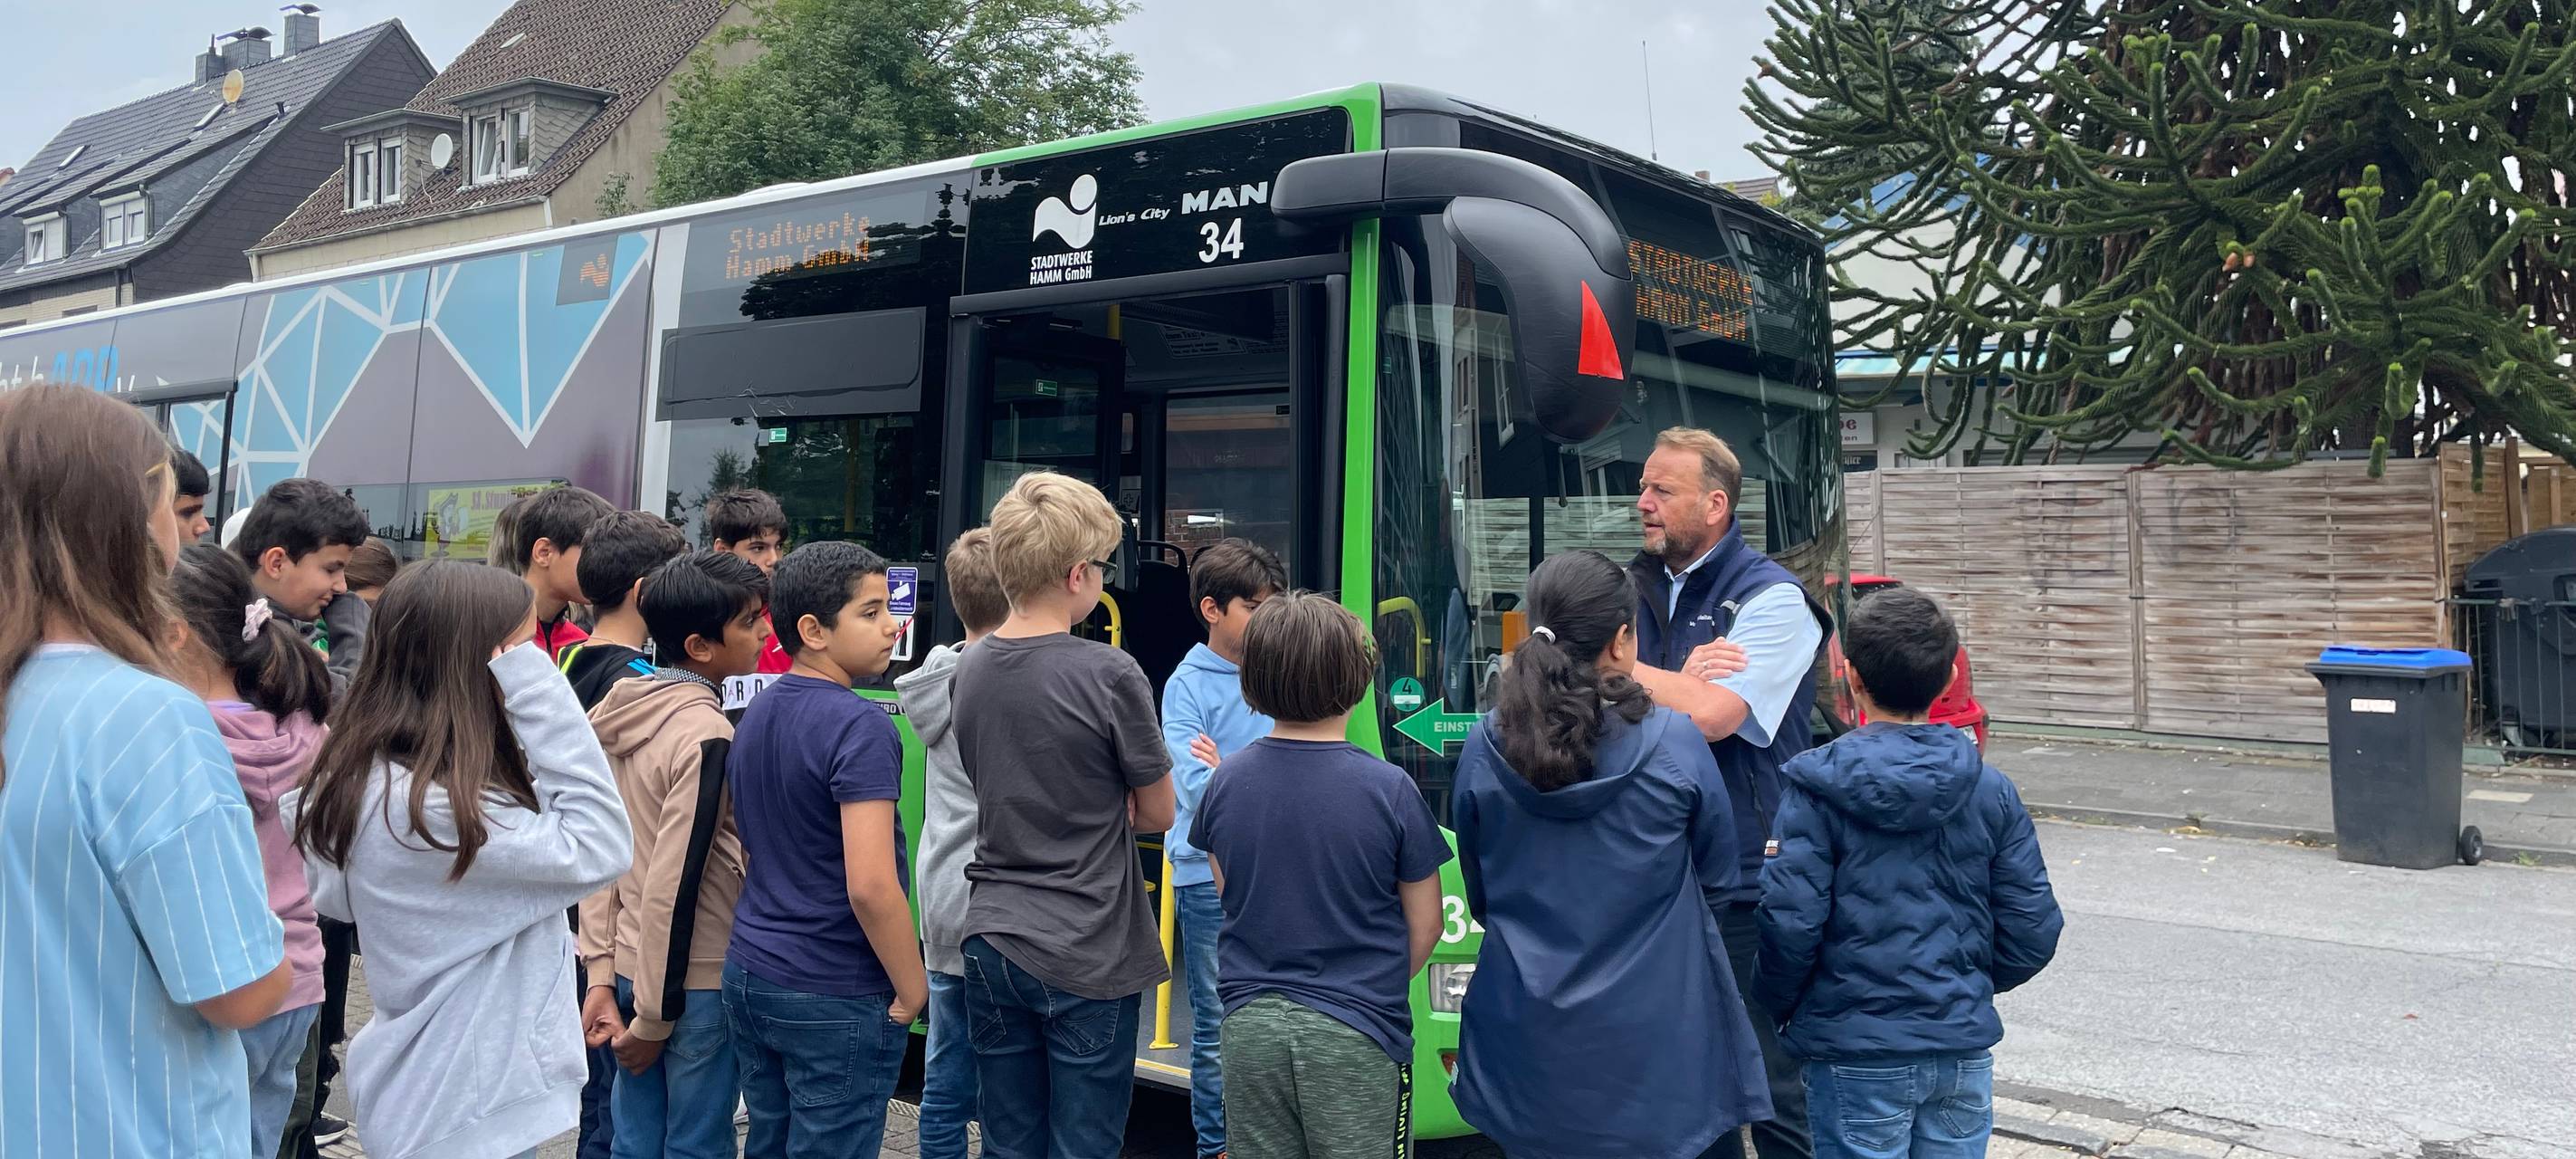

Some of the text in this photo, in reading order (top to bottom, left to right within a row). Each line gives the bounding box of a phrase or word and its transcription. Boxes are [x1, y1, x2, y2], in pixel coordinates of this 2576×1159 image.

[1181, 181, 1268, 215] MAN
[729, 211, 871, 251] Stadtwerke
[1098, 206, 1170, 226] Lion's City
[1198, 217, 1244, 263] 34
[725, 237, 870, 279] Hamm GmbH
[1029, 265, 1092, 285] HAMM GmbH
[1030, 250, 1093, 270] STADTWERKE
[1627, 239, 1753, 305] STADTWERKE
[1636, 283, 1747, 341] HAMM GmbH
[1402, 678, 1413, 694] 4
[1434, 721, 1474, 733] EINST
